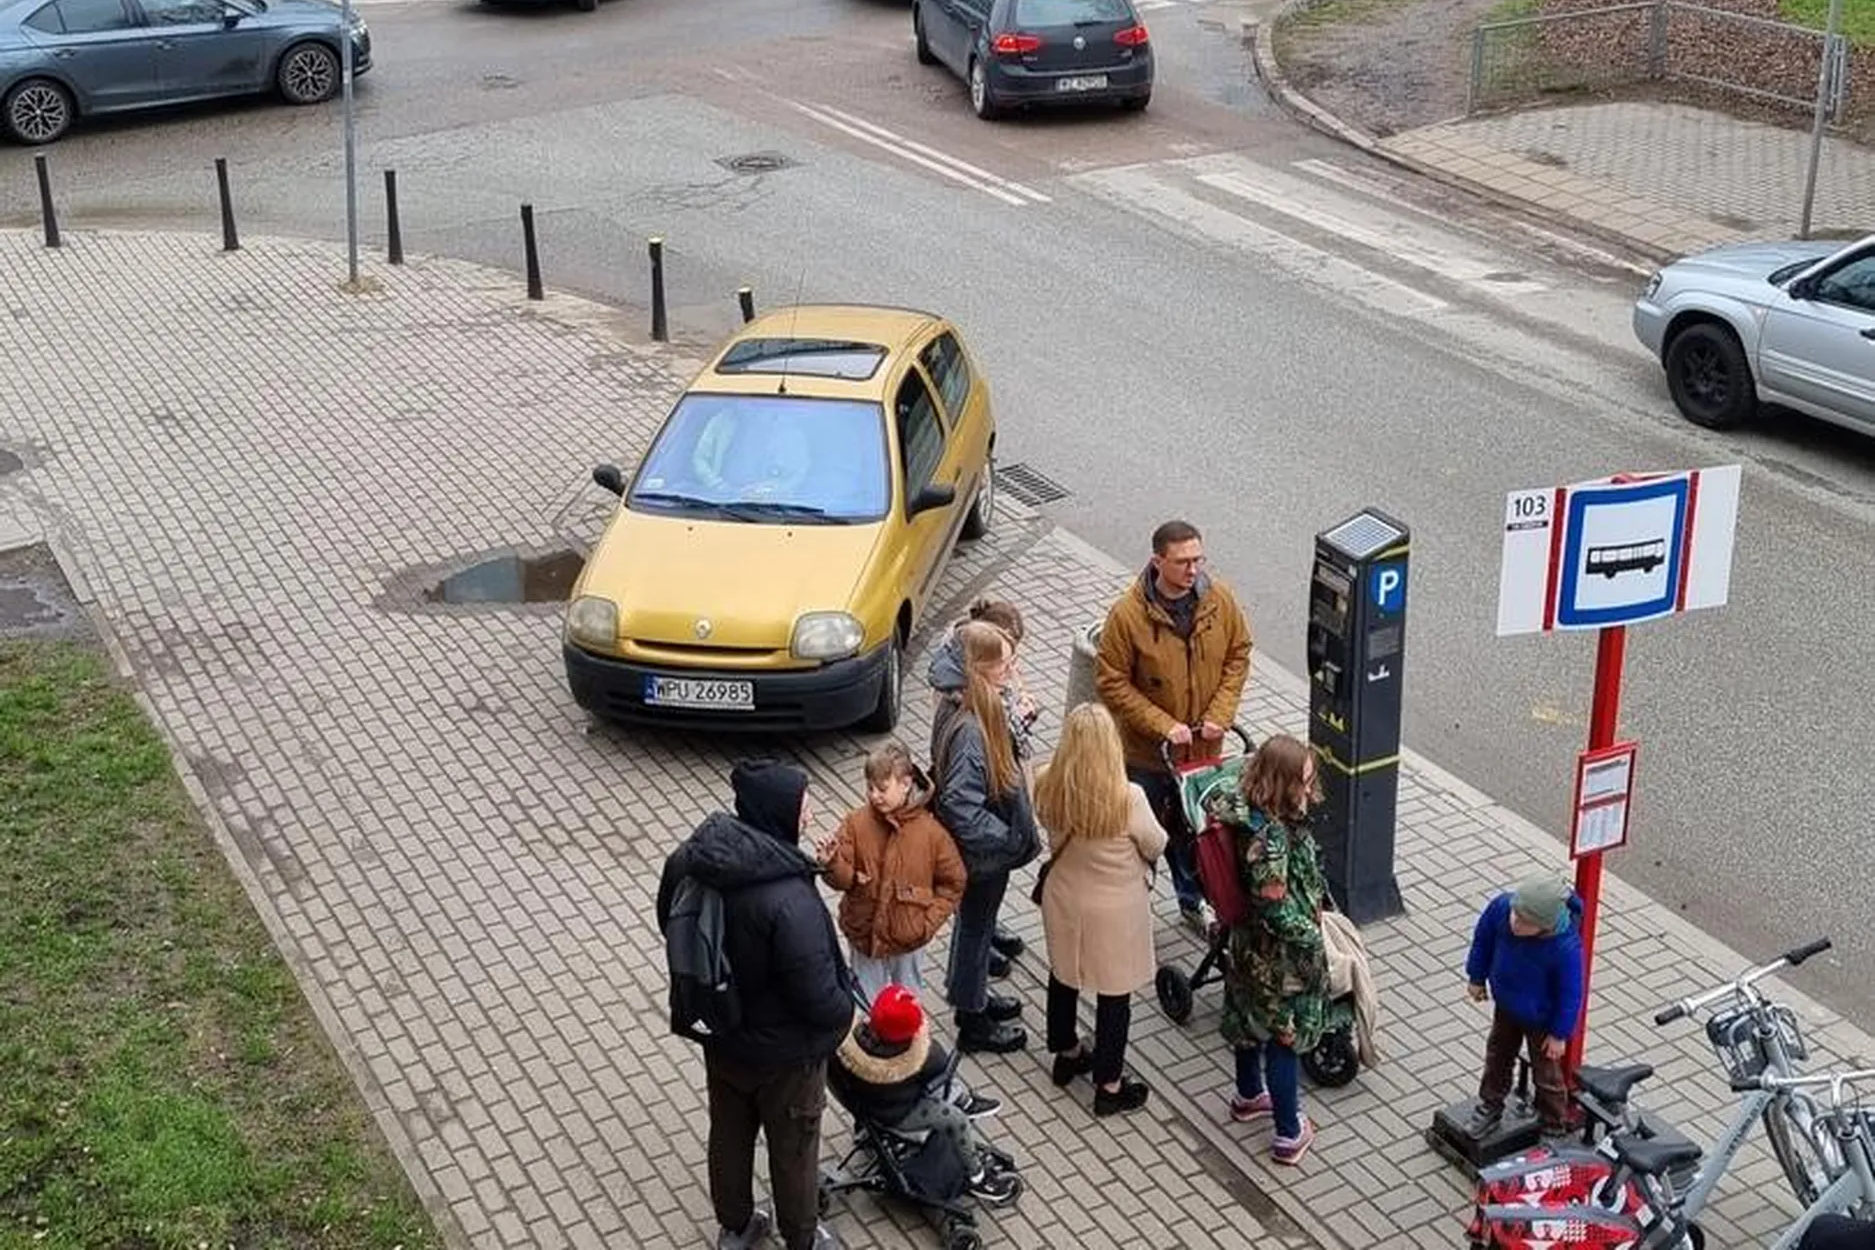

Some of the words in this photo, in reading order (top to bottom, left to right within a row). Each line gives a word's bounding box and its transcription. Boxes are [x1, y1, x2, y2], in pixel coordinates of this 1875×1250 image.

[1515, 495, 1546, 517] 103
[1378, 570, 1400, 606] P
[657, 680, 689, 700] WPU
[696, 681, 751, 702] 26985
